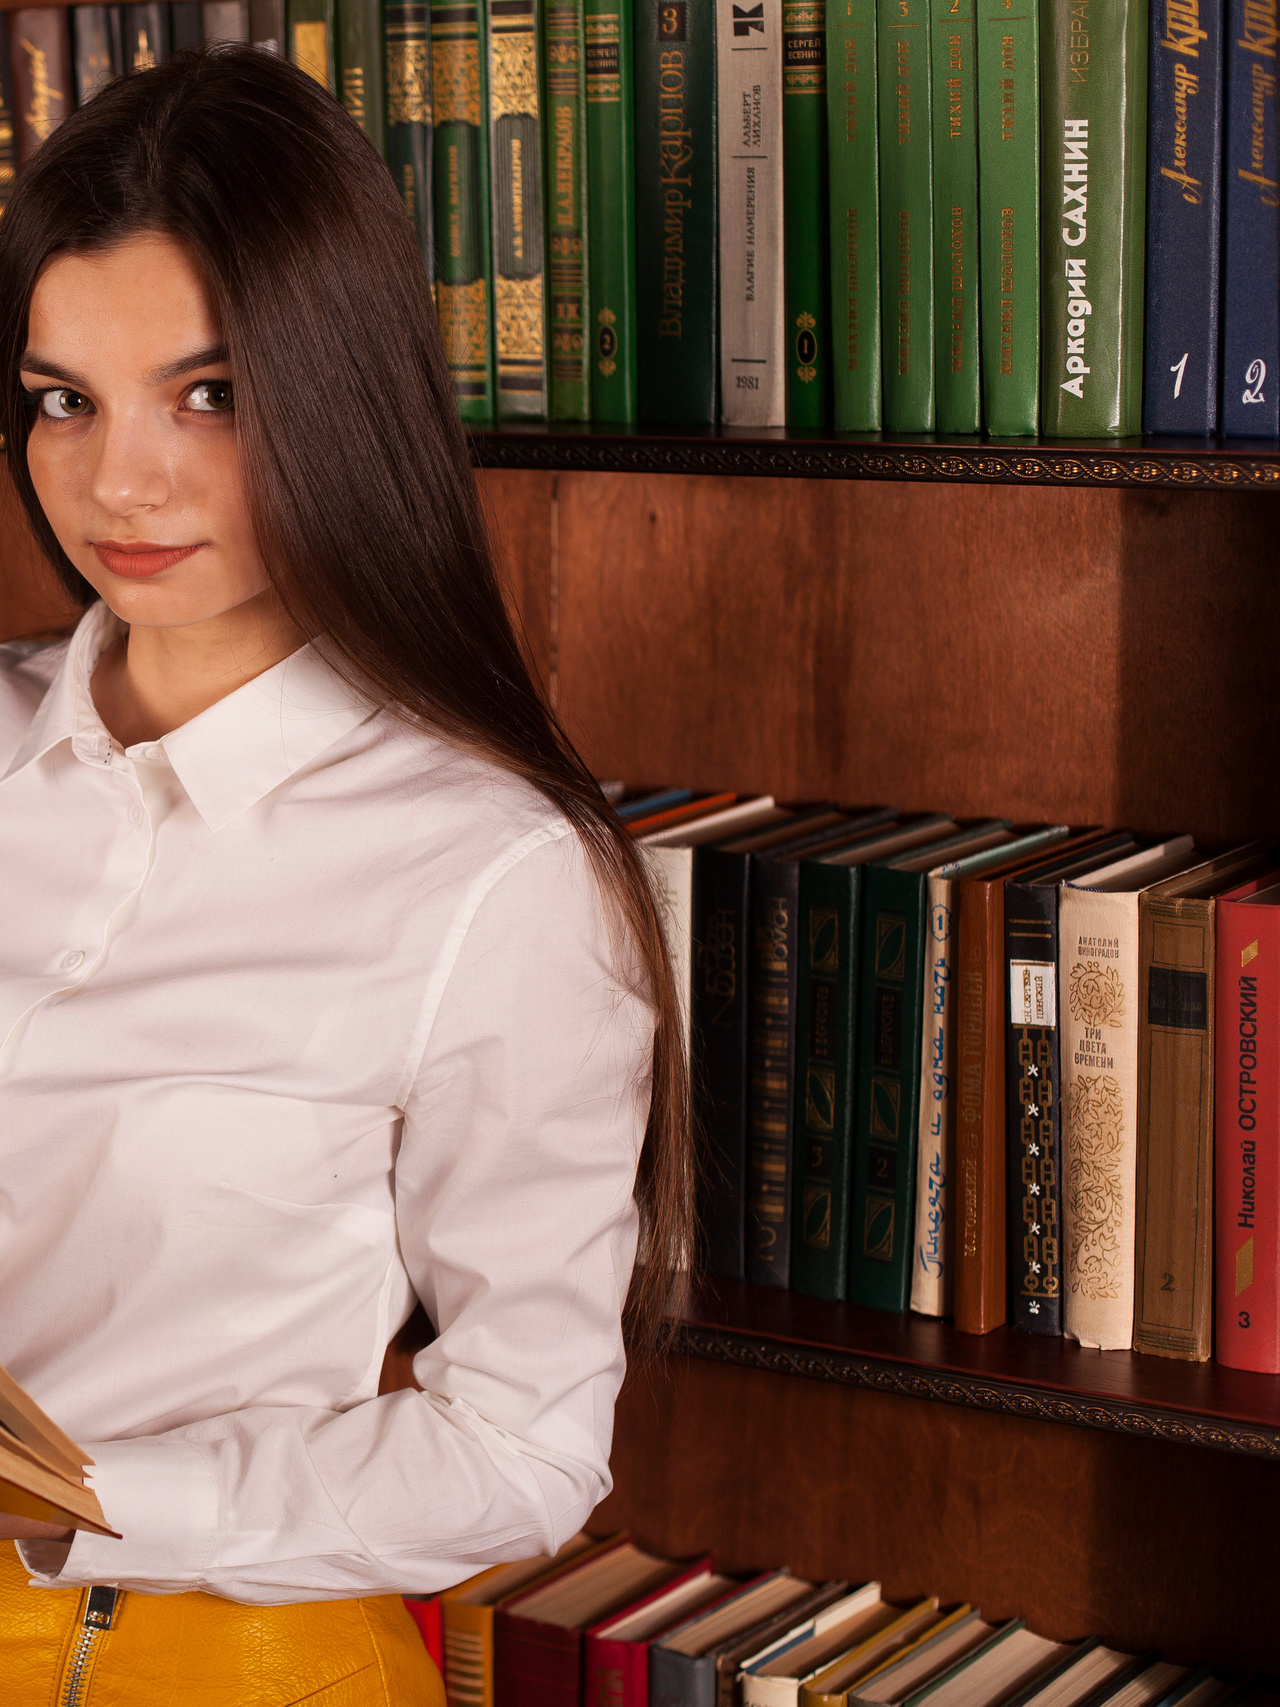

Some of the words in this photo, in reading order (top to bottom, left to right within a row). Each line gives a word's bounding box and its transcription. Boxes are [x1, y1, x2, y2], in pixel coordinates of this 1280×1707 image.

[662, 8, 678, 33] 3
[899, 1, 909, 17] 3
[787, 37, 821, 48] СЕРГЕЙ
[787, 50, 821, 59] ЕСЕНИН
[845, 38, 859, 75] ДОН
[896, 41, 911, 78] ДОН
[949, 34, 963, 71] ДОН
[1002, 34, 1016, 72] ДОН
[1070, 0, 1089, 83] ИЗБРА
[660, 48, 692, 187] Карпов
[742, 91, 752, 147] АЛЬБЕРТ
[752, 83, 762, 148] ЛИХАНОВ
[844, 81, 858, 142] ТИХИЙ
[895, 83, 910, 145] ТИХИЙ
[947, 77, 962, 140] ТИХИЙ
[999, 77, 1015, 141] ТИХИЙ
[1161, 63, 1202, 204] Александр
[1238, 63, 1280, 206] Александр
[745, 167, 756, 246] НАМЕРЕНИЯ
[1061, 118, 1089, 247] САХНИН
[660, 189, 692, 341] Владимир
[745, 250, 756, 302] БЛАГИЕ
[846, 208, 859, 292] ШОЛОХОВ
[897, 209, 911, 295] ШОЛОХОВ
[951, 206, 964, 293] ШОЛОХОВ
[1000, 207, 1014, 294] ШОЛОХОВ
[846, 298, 859, 371] МИХАИЛ
[897, 300, 911, 376] МИХАИЛ
[951, 297, 964, 373] МИХАИЛ
[1000, 298, 1014, 375] МИХАИЛ
[1060, 259, 1092, 399] Аркадий
[735, 375, 760, 390] 1981
[1170, 353, 1189, 398] 1
[1243, 358, 1267, 405] 2
[1078, 936, 1119, 948] АНАТОЛИЙ
[1078, 946, 1119, 958] ВИНОГРАДОВ
[933, 957, 952, 1015] ночь
[930, 1026, 950, 1101] одна
[1074, 1053, 1114, 1069] ВРЕМЕНИ
[1079, 1039, 1107, 1055] ЦВЕТА
[1085, 1027, 1102, 1041] ТРИ
[1237, 976, 1259, 1132] ОСТРОВСКИЙ
[963, 1063, 983, 1123] ФОМА
[1237, 1138, 1256, 1229] Николай
[1161, 1272, 1176, 1293] 2
[1238, 1311, 1251, 1330] 3
